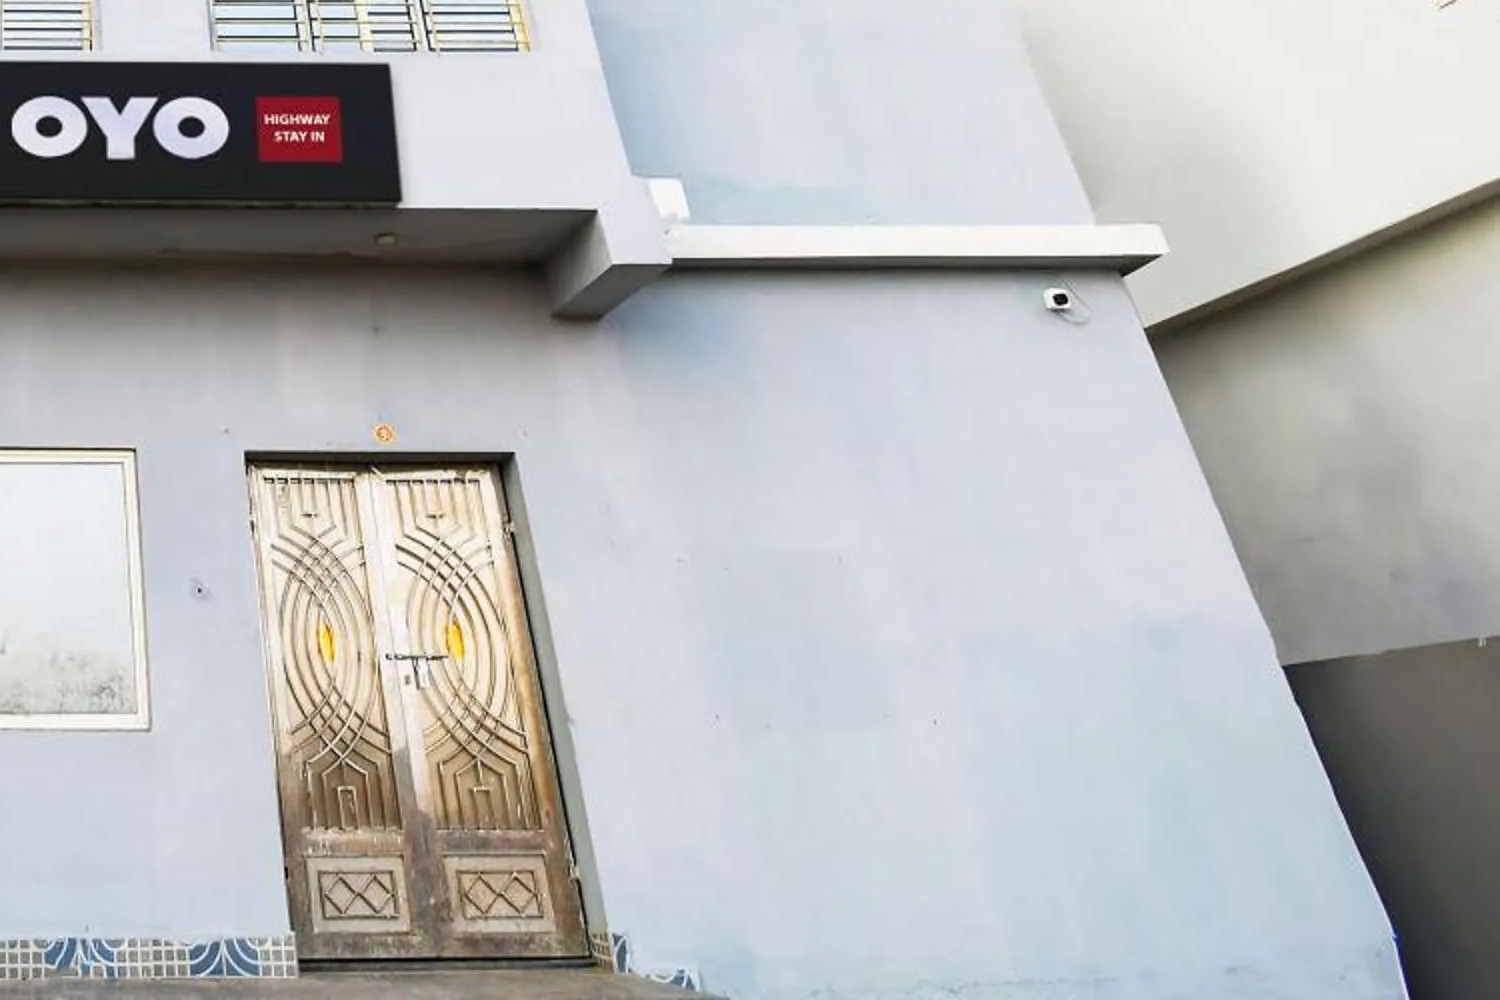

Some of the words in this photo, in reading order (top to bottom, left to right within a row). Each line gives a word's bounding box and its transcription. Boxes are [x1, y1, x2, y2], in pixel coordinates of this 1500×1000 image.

[263, 113, 331, 126] HIGHWAY
[11, 96, 230, 159] OYO
[273, 131, 307, 142] STAY
[310, 131, 326, 142] IN
